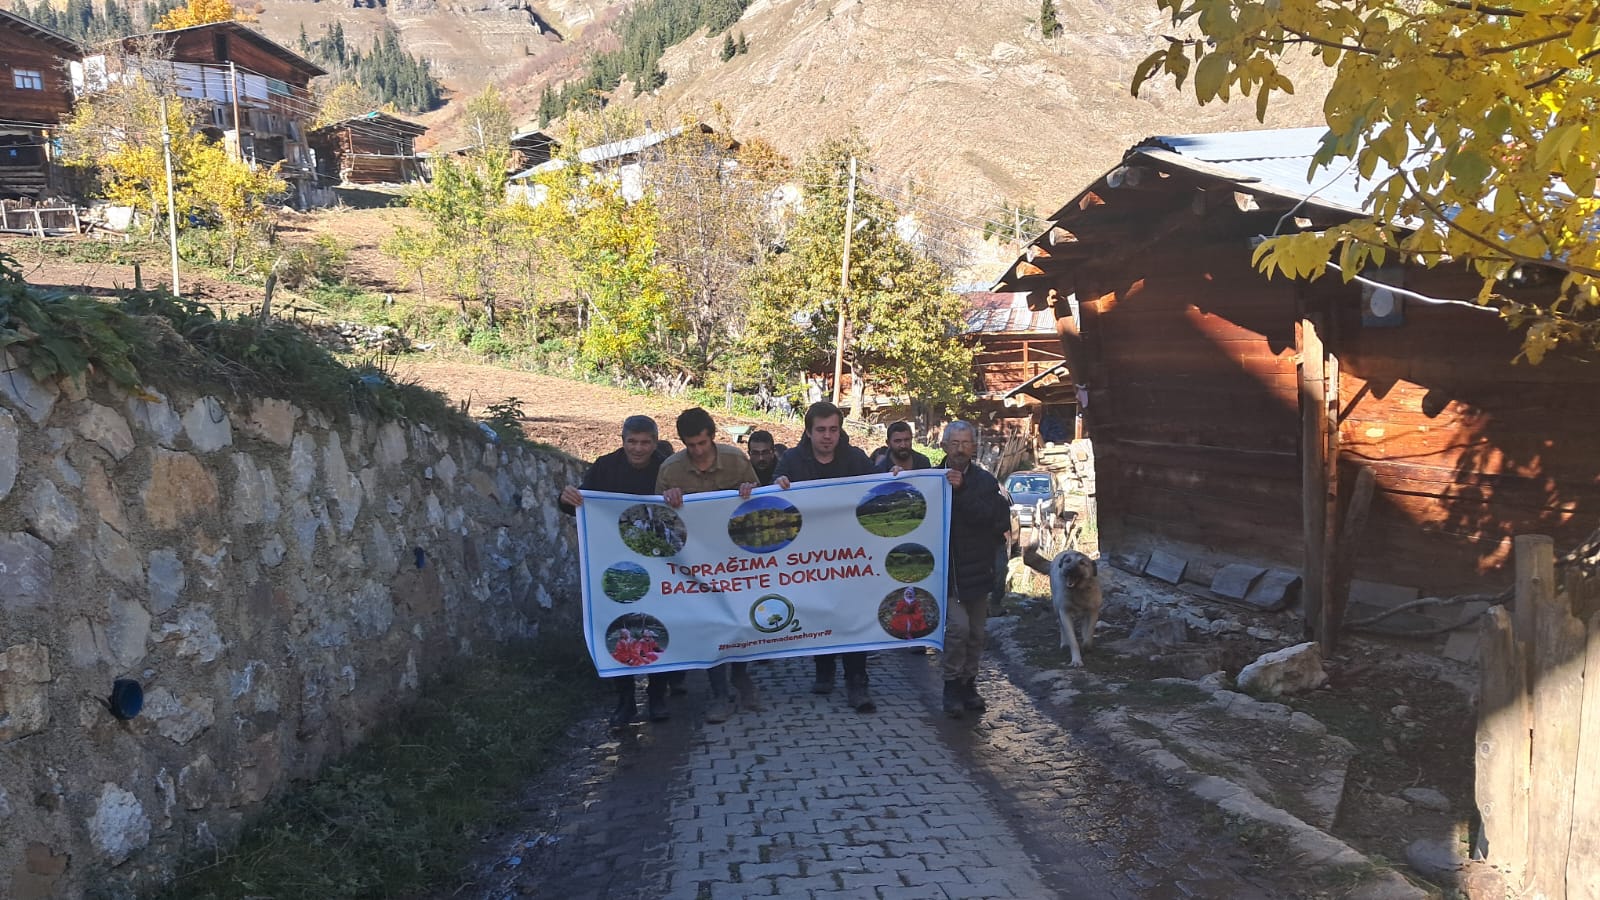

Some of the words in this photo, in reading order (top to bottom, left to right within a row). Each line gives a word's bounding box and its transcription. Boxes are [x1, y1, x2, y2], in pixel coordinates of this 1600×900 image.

[666, 556, 778, 577] TOPRAĞIMA
[786, 546, 873, 566] SUYUMA,
[779, 564, 880, 586] DOKUNMA.
